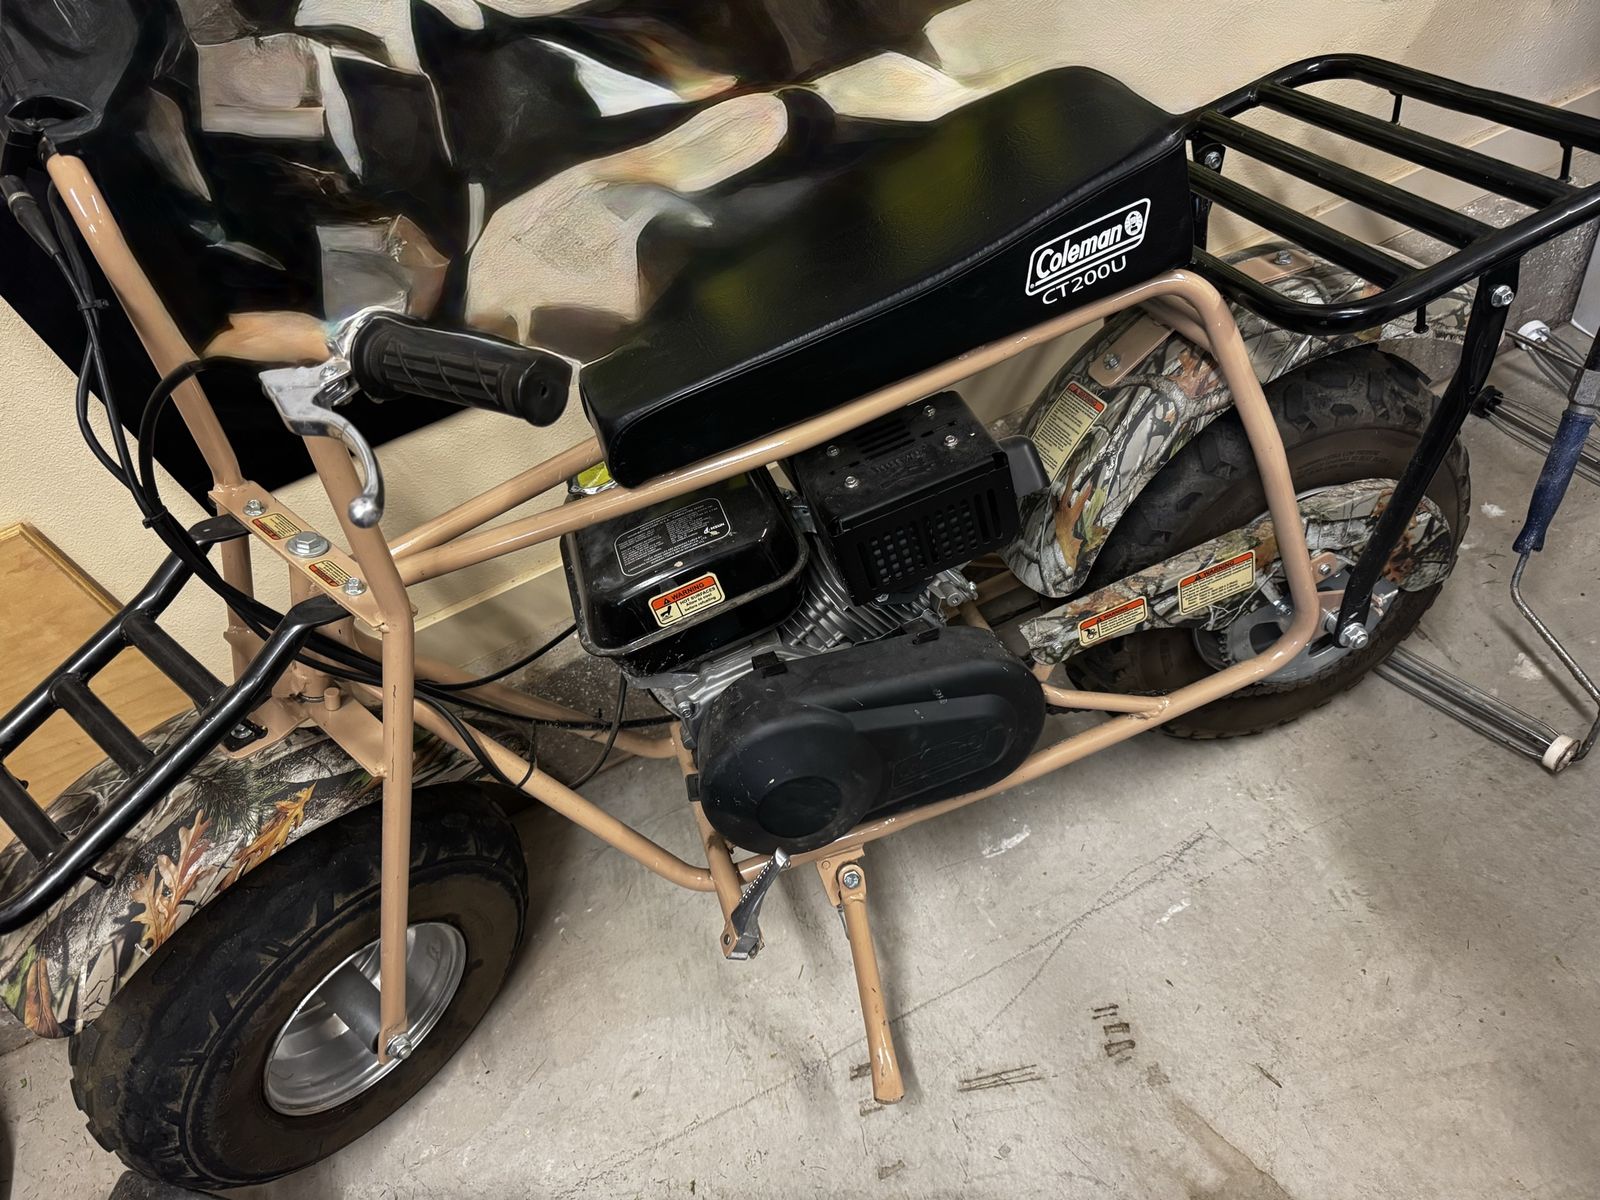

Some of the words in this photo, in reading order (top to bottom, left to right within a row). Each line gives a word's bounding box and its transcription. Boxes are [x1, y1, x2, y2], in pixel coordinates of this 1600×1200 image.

[1036, 224, 1123, 279] Coleman
[1042, 255, 1127, 304] CT200U
[671, 582, 705, 600] WARNING
[680, 597, 690, 605] HOT
[690, 586, 716, 600] SURFACES
